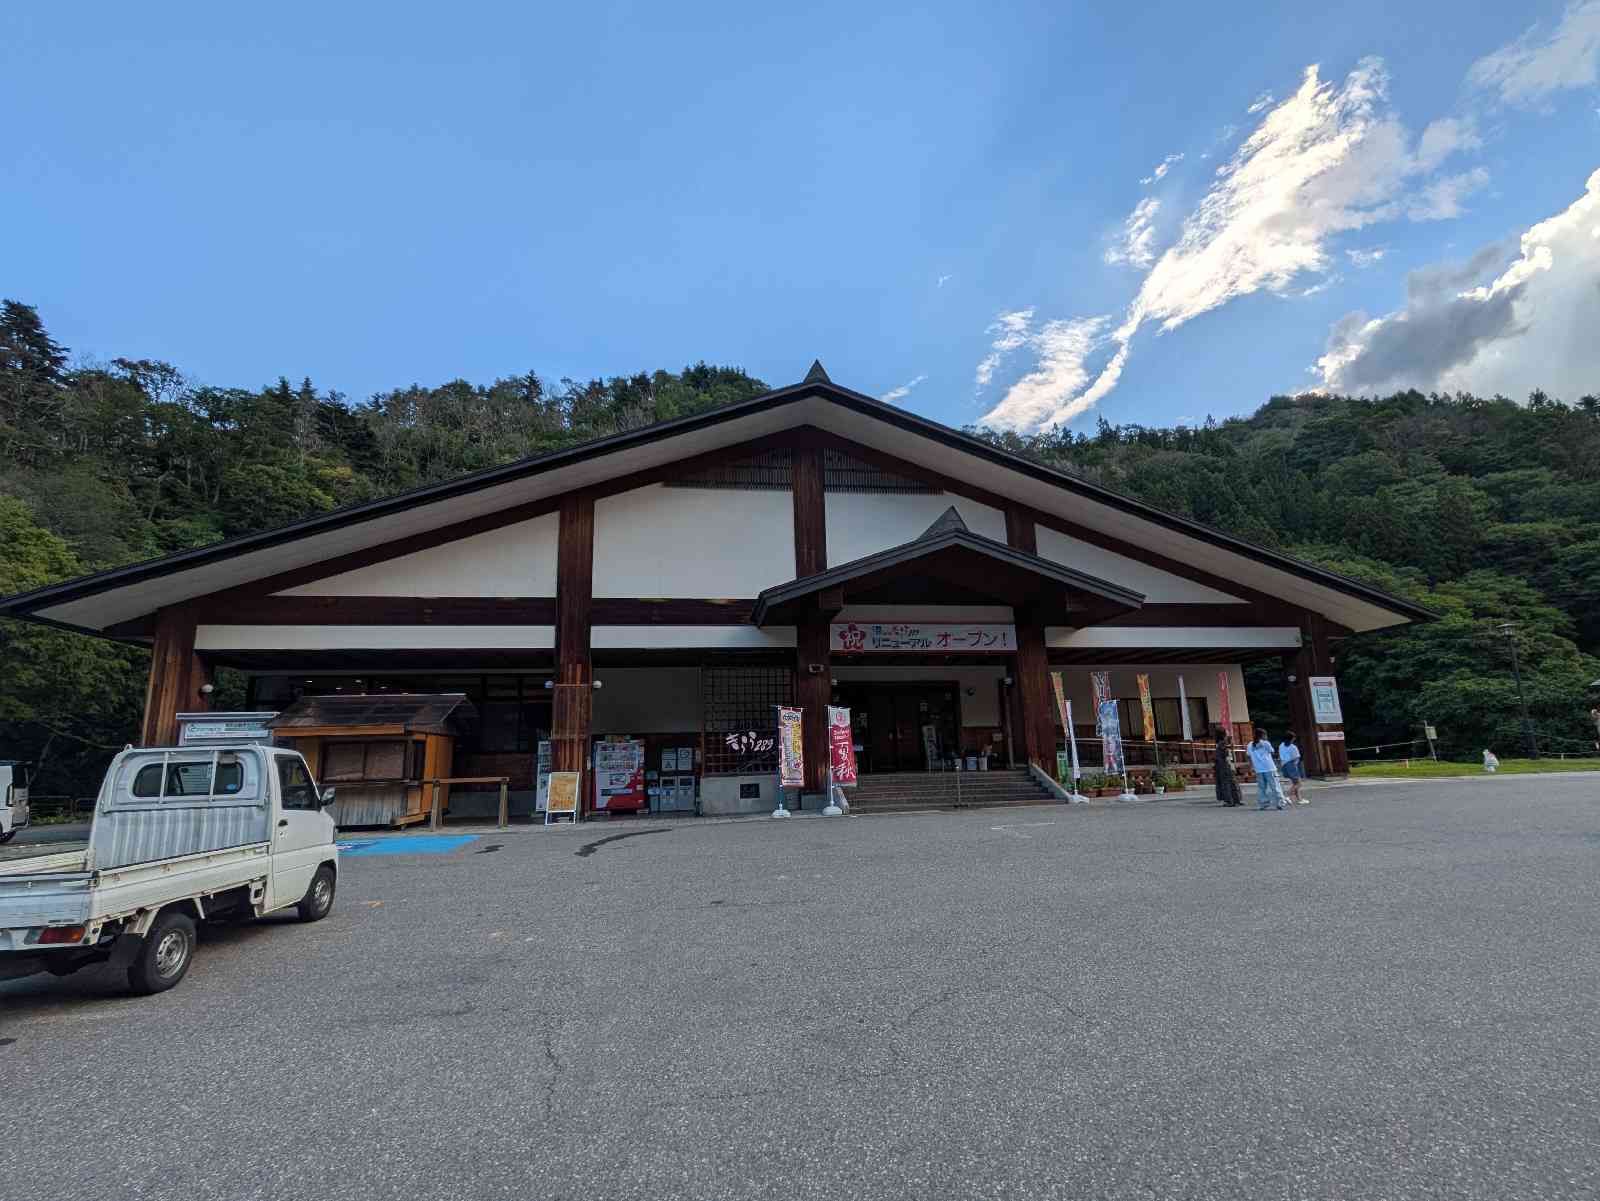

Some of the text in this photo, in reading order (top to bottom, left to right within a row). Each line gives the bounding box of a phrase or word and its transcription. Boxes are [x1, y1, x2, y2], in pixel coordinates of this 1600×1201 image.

[871, 637, 932, 649] リニューアル
